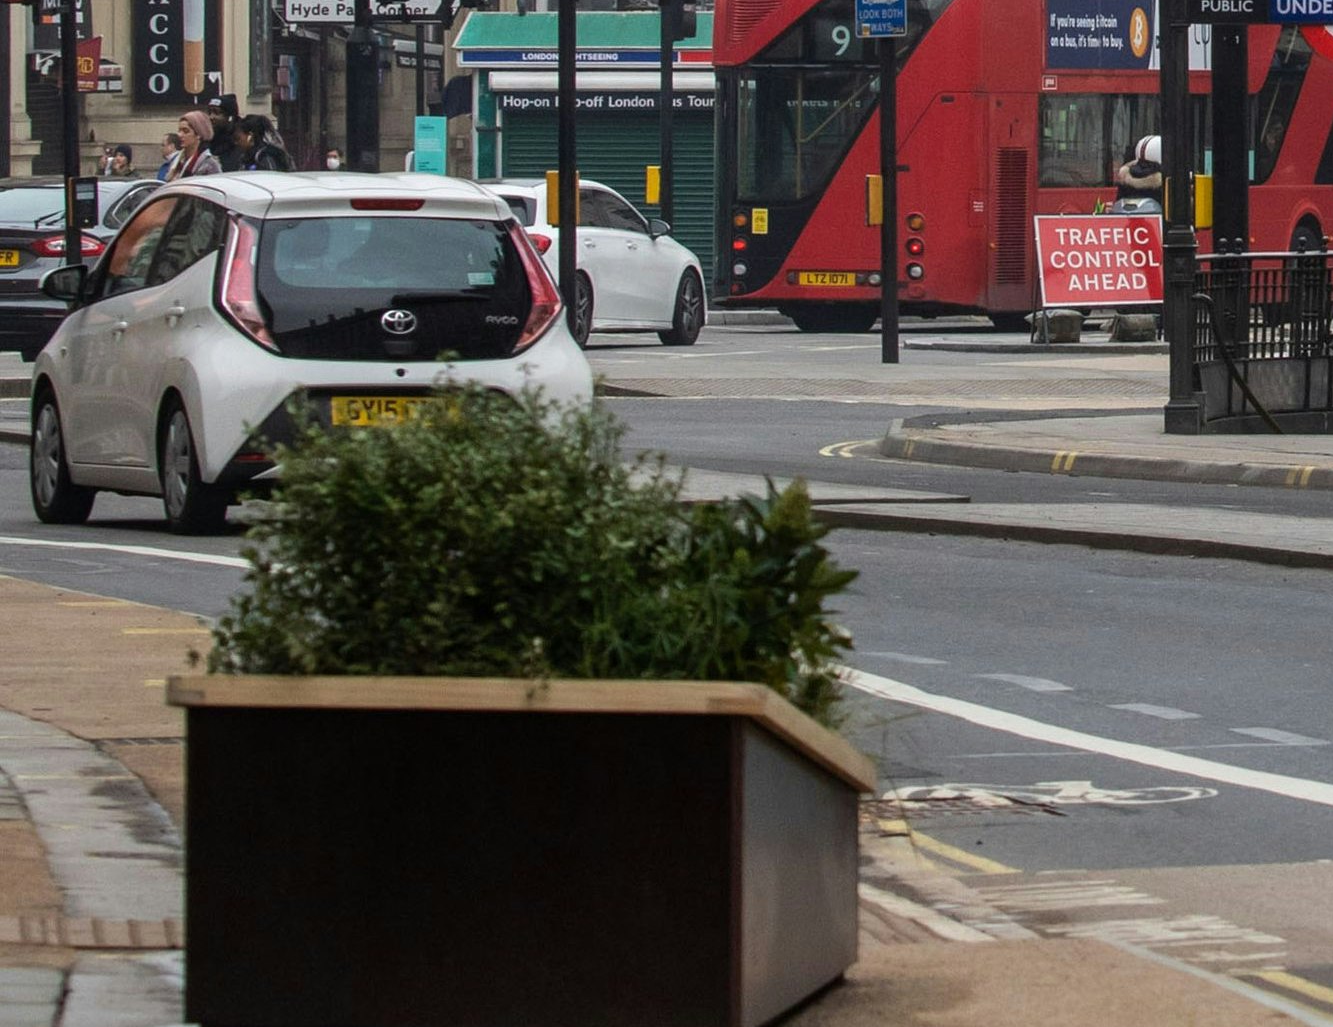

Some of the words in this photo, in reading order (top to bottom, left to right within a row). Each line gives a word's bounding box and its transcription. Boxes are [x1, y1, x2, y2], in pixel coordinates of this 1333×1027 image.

[291, 4, 330, 17] Hyde
[1201, 0, 1254, 13] PUBLIC
[859, 10, 880, 19] LOOK
[882, 9, 904, 19] BOTH
[1050, 13, 1056, 27] If
[1056, 14, 1075, 30] you're
[1076, 15, 1095, 31] seeing
[831, 25, 851, 57] 9
[1050, 36, 1059, 47] on
[1102, 35, 1109, 47] to
[521, 53, 560, 61] LONDON
[503, 95, 550, 110] Hop-on
[607, 95, 655, 108] London
[1055, 227, 1149, 245] TRAFFIC
[1050, 250, 1160, 268] CONTROL
[806, 274, 826, 284] LTZ
[829, 273, 848, 284] 1071
[1068, 273, 1148, 291] AHEAD
[485, 315, 519, 325] AYGO
